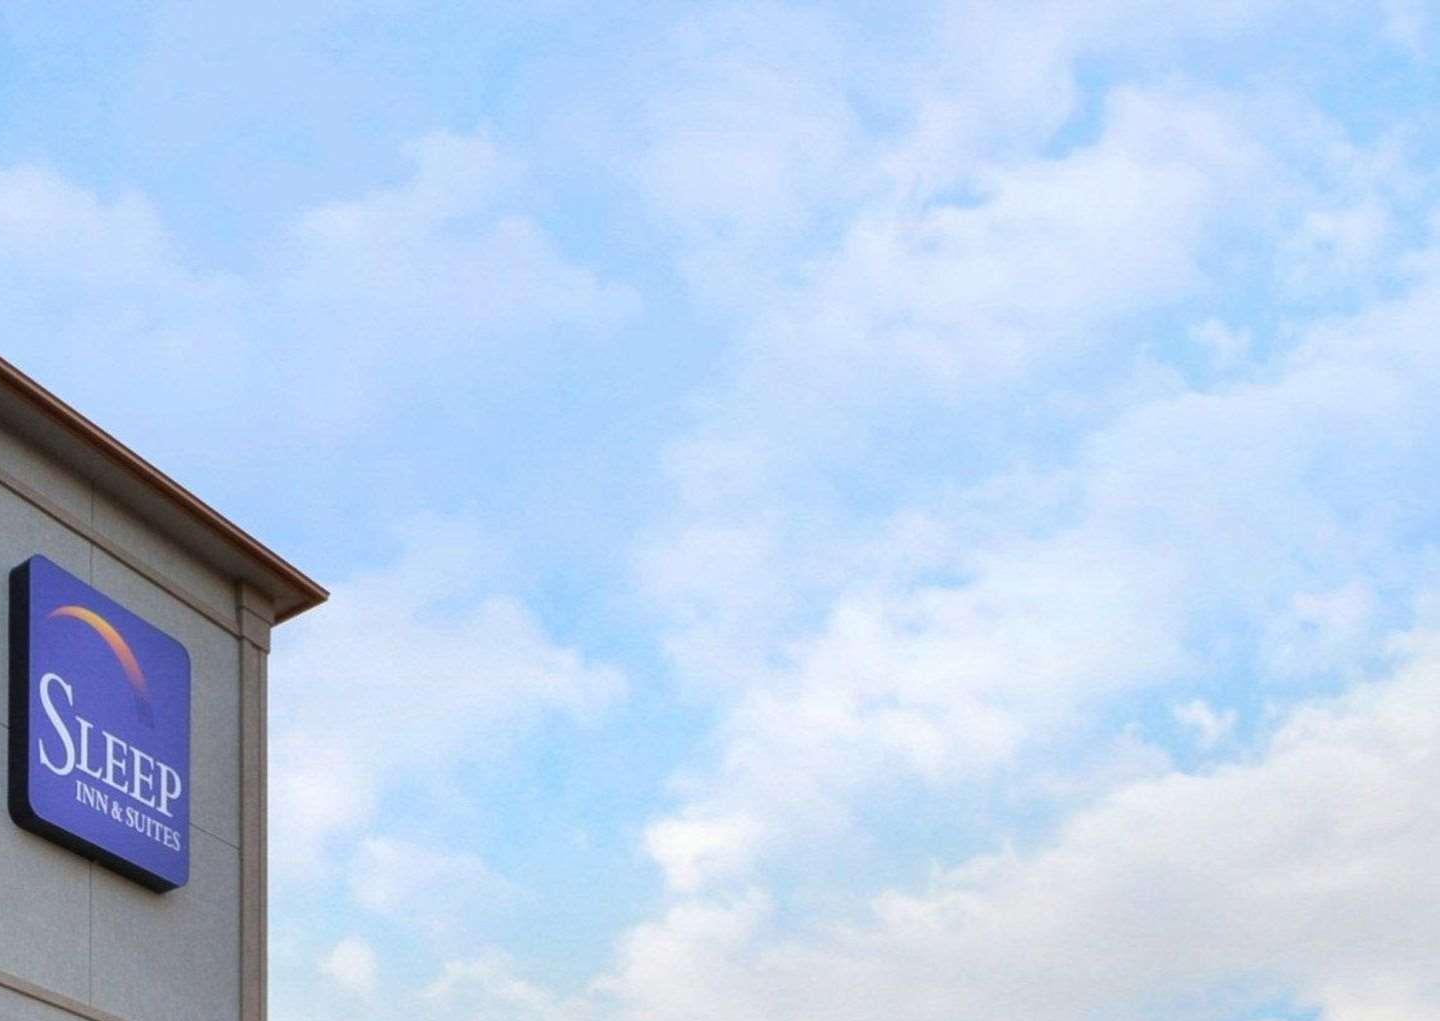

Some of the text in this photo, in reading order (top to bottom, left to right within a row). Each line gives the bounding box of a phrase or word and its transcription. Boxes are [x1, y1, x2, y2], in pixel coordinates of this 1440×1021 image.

[38, 672, 182, 818] SLEEP
[75, 780, 181, 852] INN & SUITES
